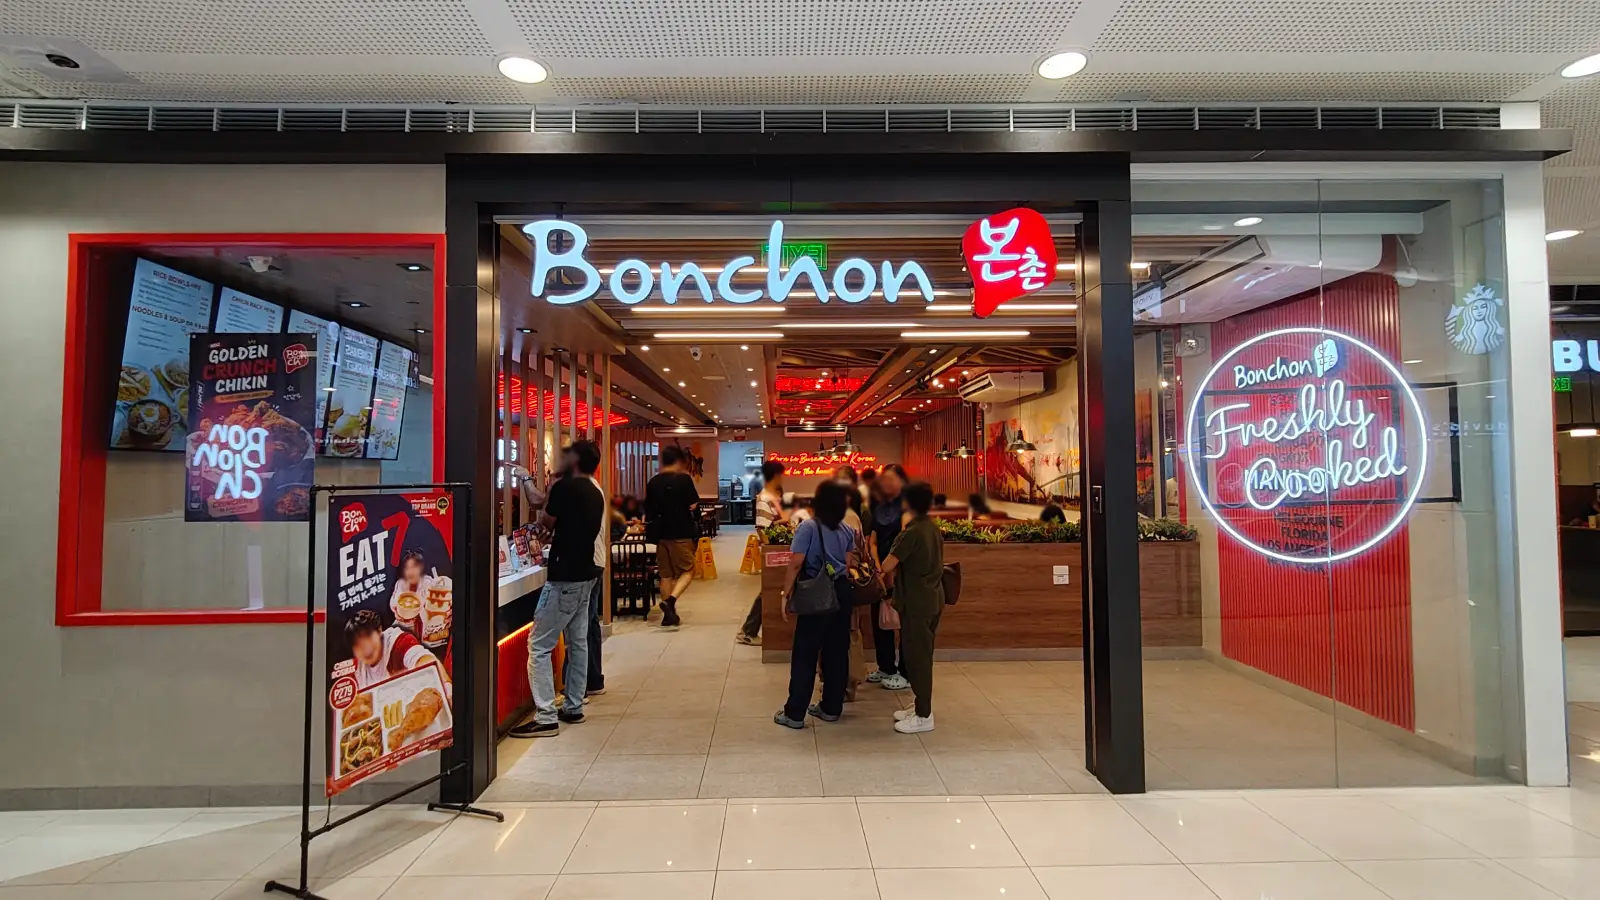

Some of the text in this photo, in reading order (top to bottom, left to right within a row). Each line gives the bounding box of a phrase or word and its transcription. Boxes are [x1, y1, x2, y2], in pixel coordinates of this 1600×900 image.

[522, 219, 936, 306] Bonchon
[972, 217, 1048, 291] 본촌
[132, 305, 163, 319] NOODLES
[203, 358, 277, 380] CRUNCH
[209, 344, 268, 364] GOLDEN
[216, 375, 268, 393] CHIKIN
[1234, 356, 1313, 388] Bonchon
[1201, 379, 1376, 459] Freshly
[1245, 426, 1408, 511] Cooked
[339, 511, 410, 588] EAT 7
[1281, 527, 1329, 541] FLORIDA
